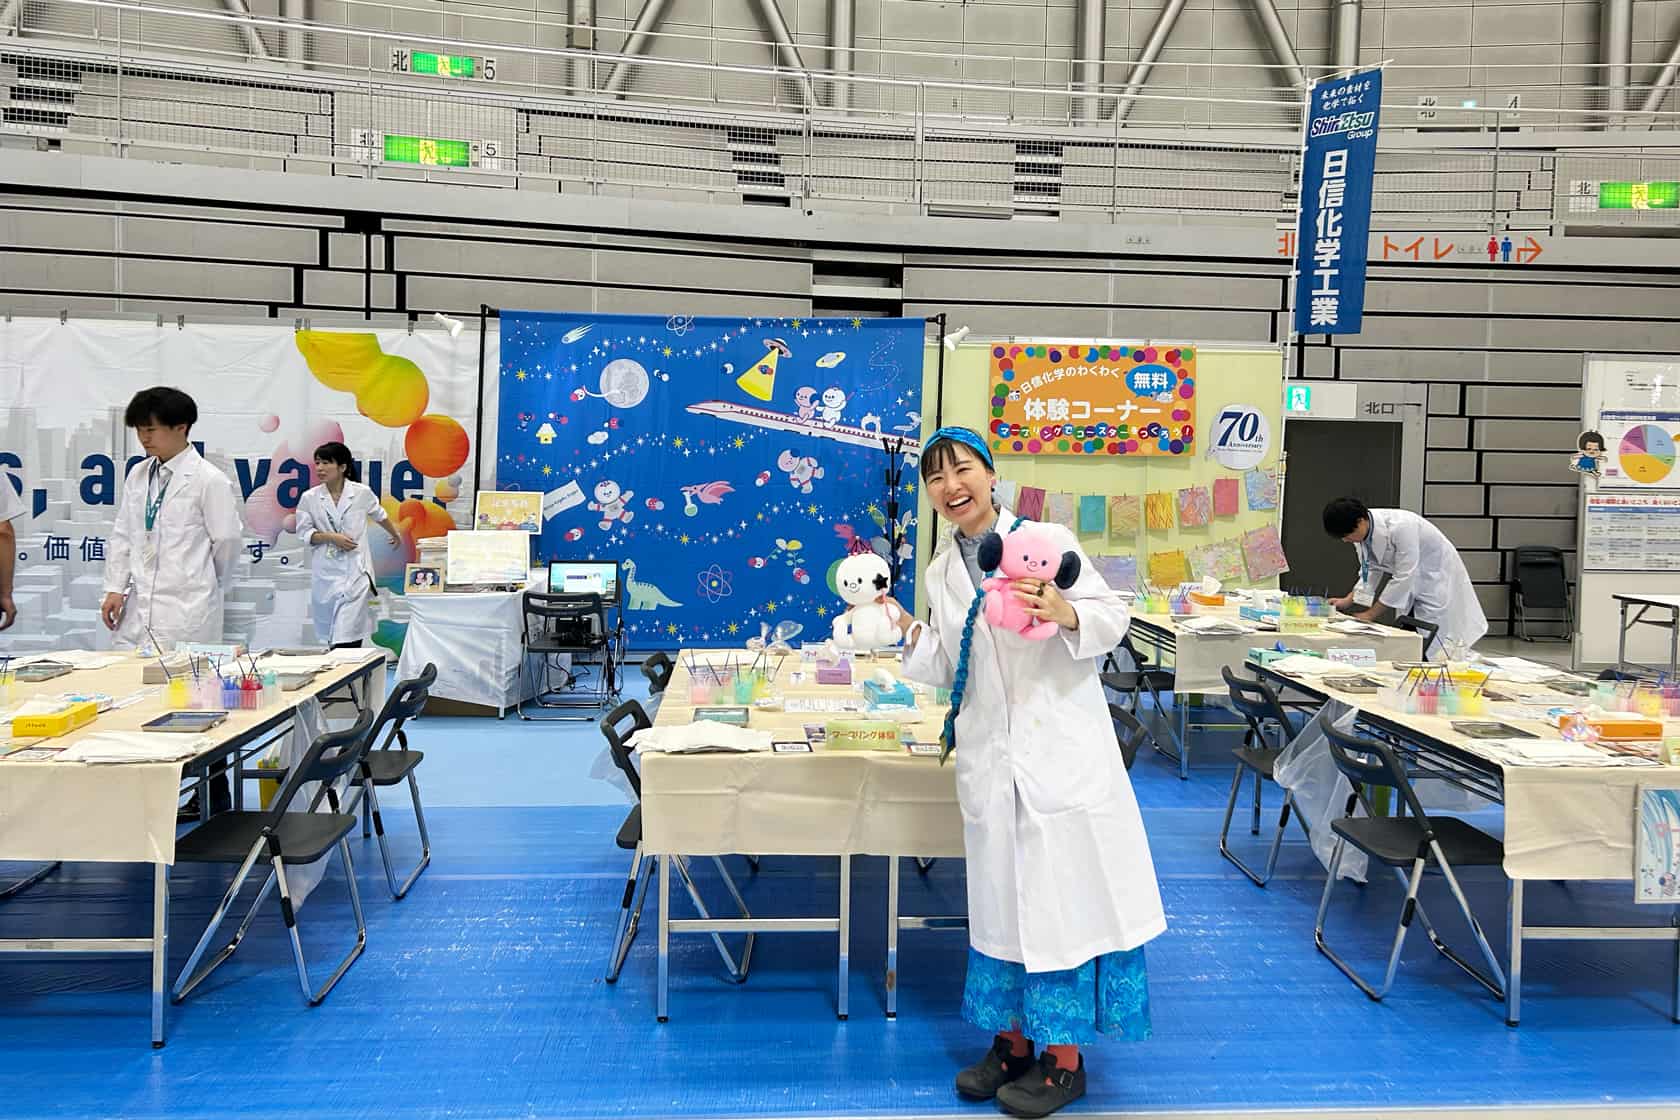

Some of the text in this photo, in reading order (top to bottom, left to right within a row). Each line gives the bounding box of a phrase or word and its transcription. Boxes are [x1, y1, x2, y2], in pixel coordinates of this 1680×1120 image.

[392, 50, 408, 72] 北
[484, 59, 496, 80] 5
[1347, 129, 1374, 140] Group
[486, 143, 497, 157] 5
[1578, 182, 1591, 195] 北
[1310, 148, 1349, 326] 日信化学工業
[1384, 235, 1454, 260] トイレ
[1020, 365, 1120, 394] 日信化学のわくわく
[1133, 372, 1168, 389] 無料
[1023, 398, 1162, 421] 体験コーナー
[1364, 401, 1394, 415] 北口
